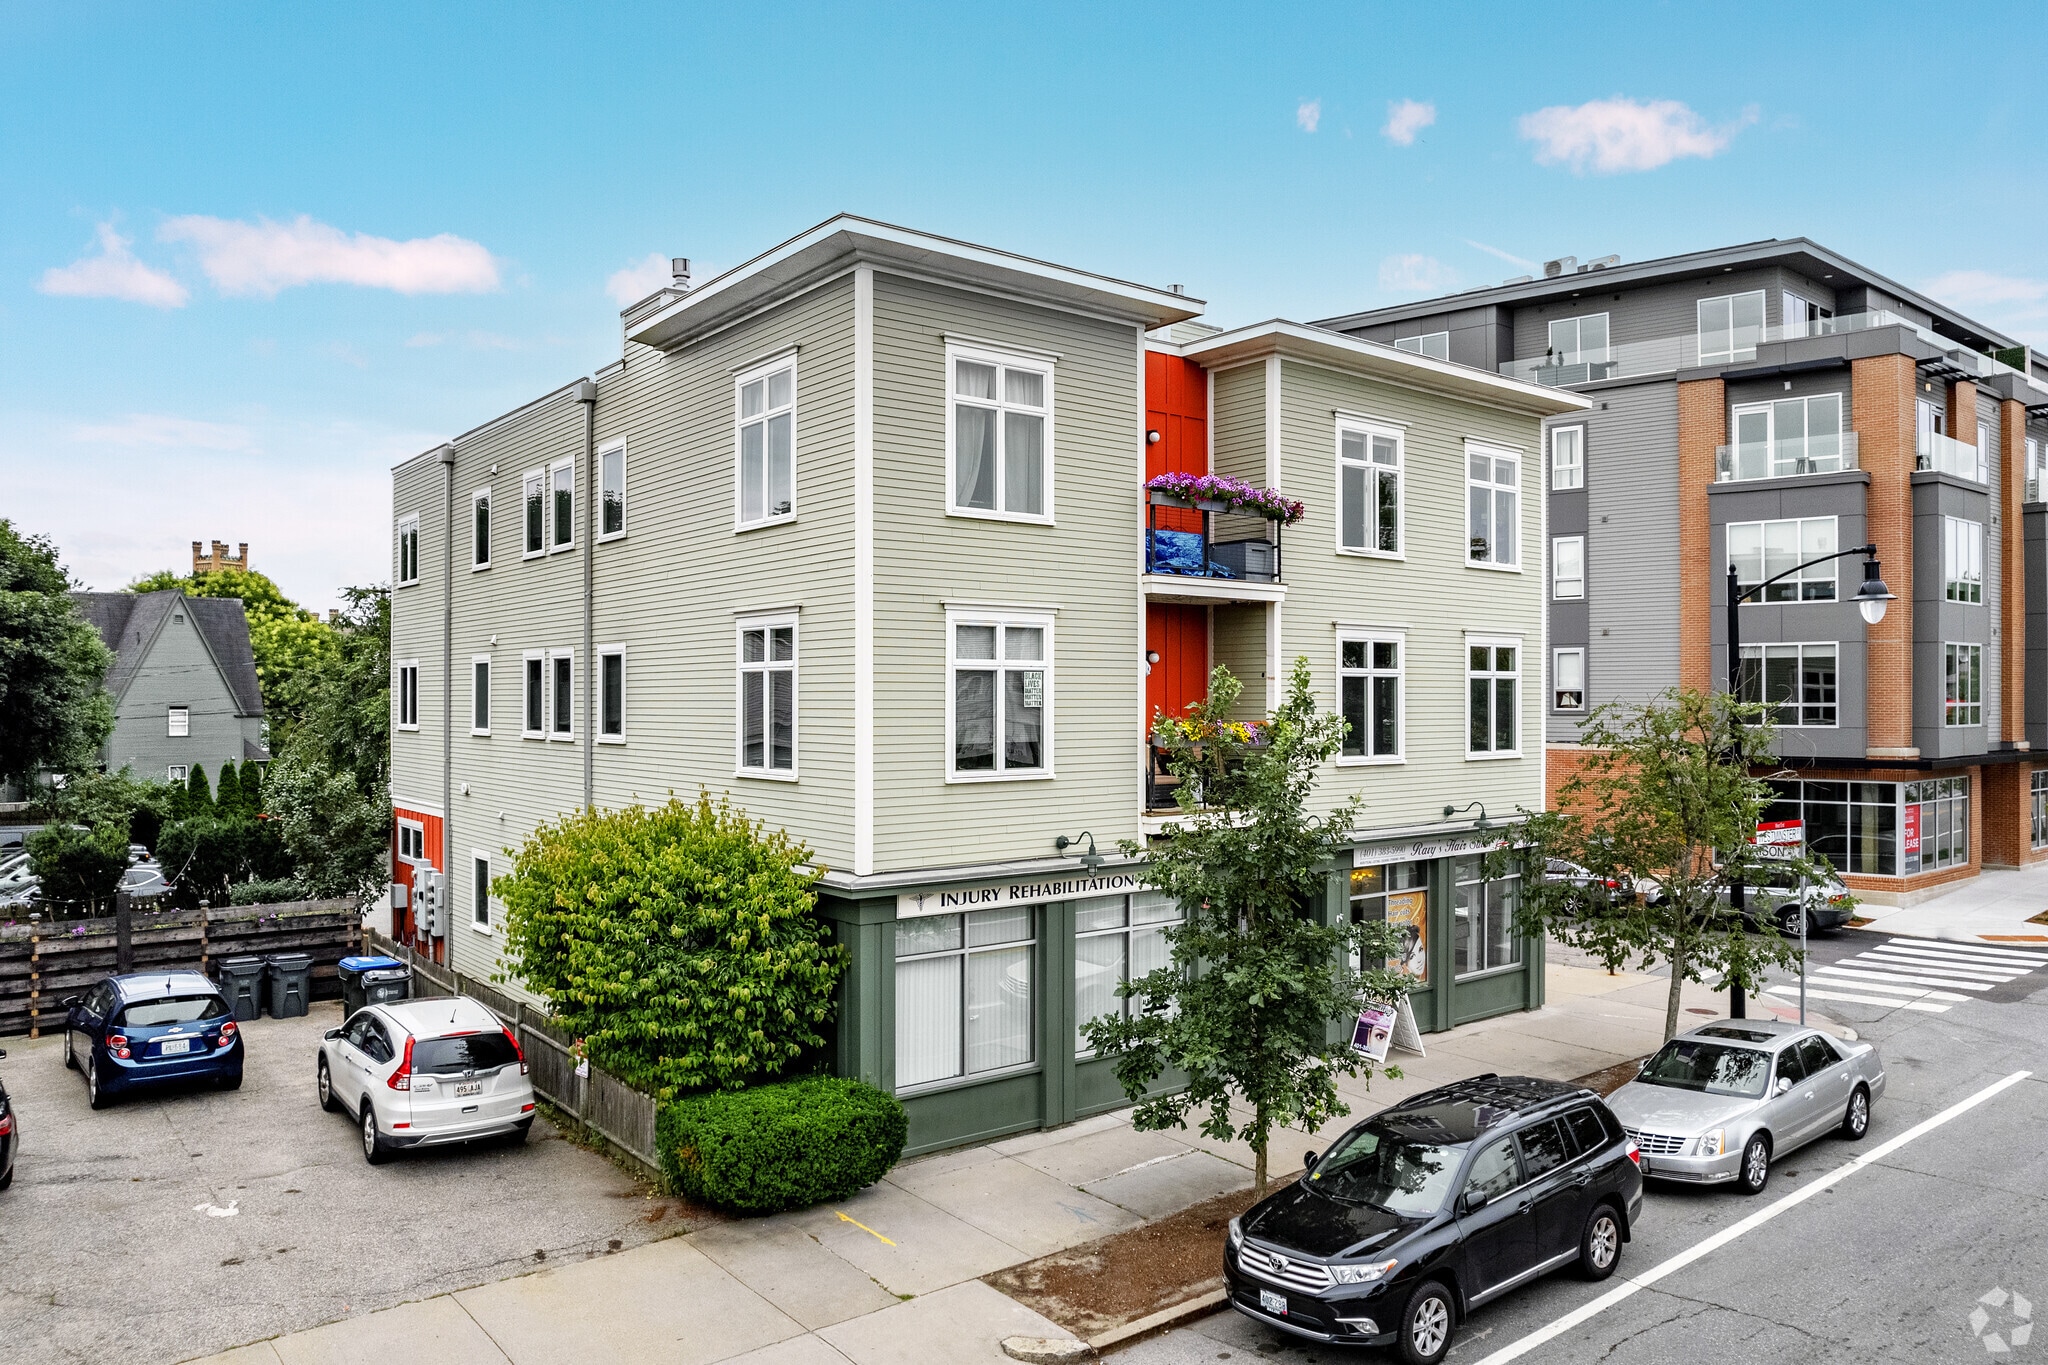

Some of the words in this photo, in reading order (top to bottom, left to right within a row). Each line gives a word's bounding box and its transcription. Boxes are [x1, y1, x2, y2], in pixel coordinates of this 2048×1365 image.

[1024, 672, 1041, 680] BLACK
[1024, 680, 1040, 688] LIVES
[1444, 838, 1466, 853] Hair
[940, 887, 1001, 907] INJURY
[1009, 874, 1135, 900] REHABILITATION
[456, 1085, 467, 1093] 495
